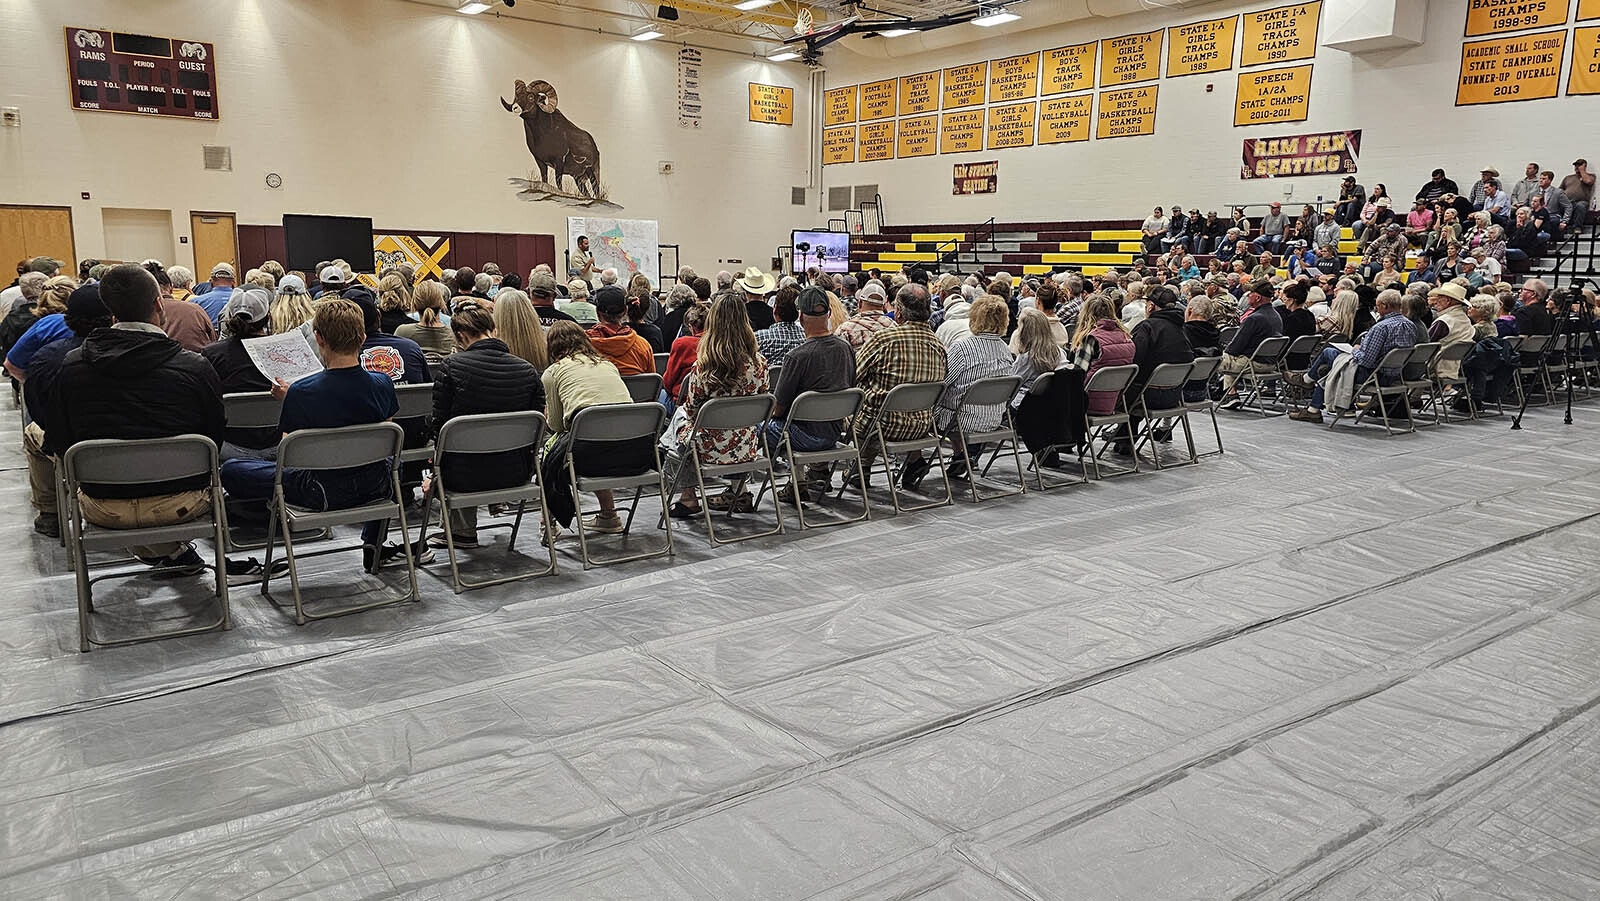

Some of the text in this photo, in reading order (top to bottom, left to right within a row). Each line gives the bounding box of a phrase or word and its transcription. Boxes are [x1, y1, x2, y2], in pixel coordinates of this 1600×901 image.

[1489, 2, 1546, 18] CHAMPS
[1257, 10, 1288, 22] STATE
[1264, 19, 1296, 31] GIRLS
[1493, 15, 1538, 29] 1998-99
[1180, 24, 1209, 36] STATE
[1262, 29, 1297, 41] TRACK
[1112, 38, 1137, 48] STATE
[1188, 33, 1215, 44] GIRLS
[1186, 42, 1216, 53] TRACK
[1258, 38, 1300, 51] CHAMPS
[1466, 39, 1560, 58] ACADEMIC SMALL SCHOOL
[1052, 48, 1074, 58] STATE
[1119, 45, 1143, 55] GIRLS
[1267, 50, 1287, 60] 1990
[80, 51, 106, 61] RAMS
[1060, 56, 1078, 65] BOYS
[1117, 54, 1144, 64] TRACK
[1182, 51, 1218, 63] CHAMPS
[134, 60, 154, 68] PERIOD
[179, 61, 206, 71] GUEST
[998, 59, 1018, 68] STATE
[1190, 62, 1207, 71] 1989
[1469, 53, 1553, 71] STATE CHAMPIONS
[951, 68, 969, 76] STATE
[1056, 64, 1081, 74] TRACK
[1113, 62, 1147, 73] CHAMPS
[906, 76, 923, 84] STATE
[956, 74, 974, 82] GIRLS
[992, 72, 1035, 84] BASKETBALL
[1053, 73, 1083, 83] CHAMPS
[1254, 72, 1294, 84] SPEECH
[1462, 67, 1556, 85] RUNNER-UP OVERALL
[126, 84, 149, 92] PLAYER
[865, 85, 880, 93] STATE
[945, 80, 983, 92] BASKETBALL
[1000, 82, 1026, 91] CHAMPS
[1258, 85, 1286, 96] 1A/2A
[1494, 85, 1520, 96] 2013
[864, 92, 891, 101] FOOTBALL
[952, 89, 976, 98] CHAMPS
[1108, 92, 1133, 101] STATE
[754, 100, 788, 109] BASKETBALL
[867, 100, 888, 109] CHAMPS
[908, 96, 930, 105] CHAMPS
[1117, 100, 1138, 108] BOYS
[1240, 95, 1304, 109] STATE CHAMPS
[996, 107, 1016, 115] STATE
[1048, 102, 1071, 110] STATE
[1002, 114, 1021, 122] GIRLS
[1042, 110, 1089, 120] VOLLEYBALL
[1100, 107, 1154, 119] BASKETBALL
[1250, 108, 1291, 120] 2010-2011
[990, 121, 1032, 131] BASKETBALL
[1050, 120, 1079, 129] CHAMPS
[1110, 117, 1142, 126] CHAMPS
[900, 128, 936, 137] VOLLEYBALL
[944, 123, 982, 132] VOLLEYBALL
[998, 130, 1024, 138] CHAMPS
[860, 137, 893, 146] BASKETBALL
[1254, 134, 1346, 157] RAM FAN
[1255, 154, 1340, 176] SEATING
